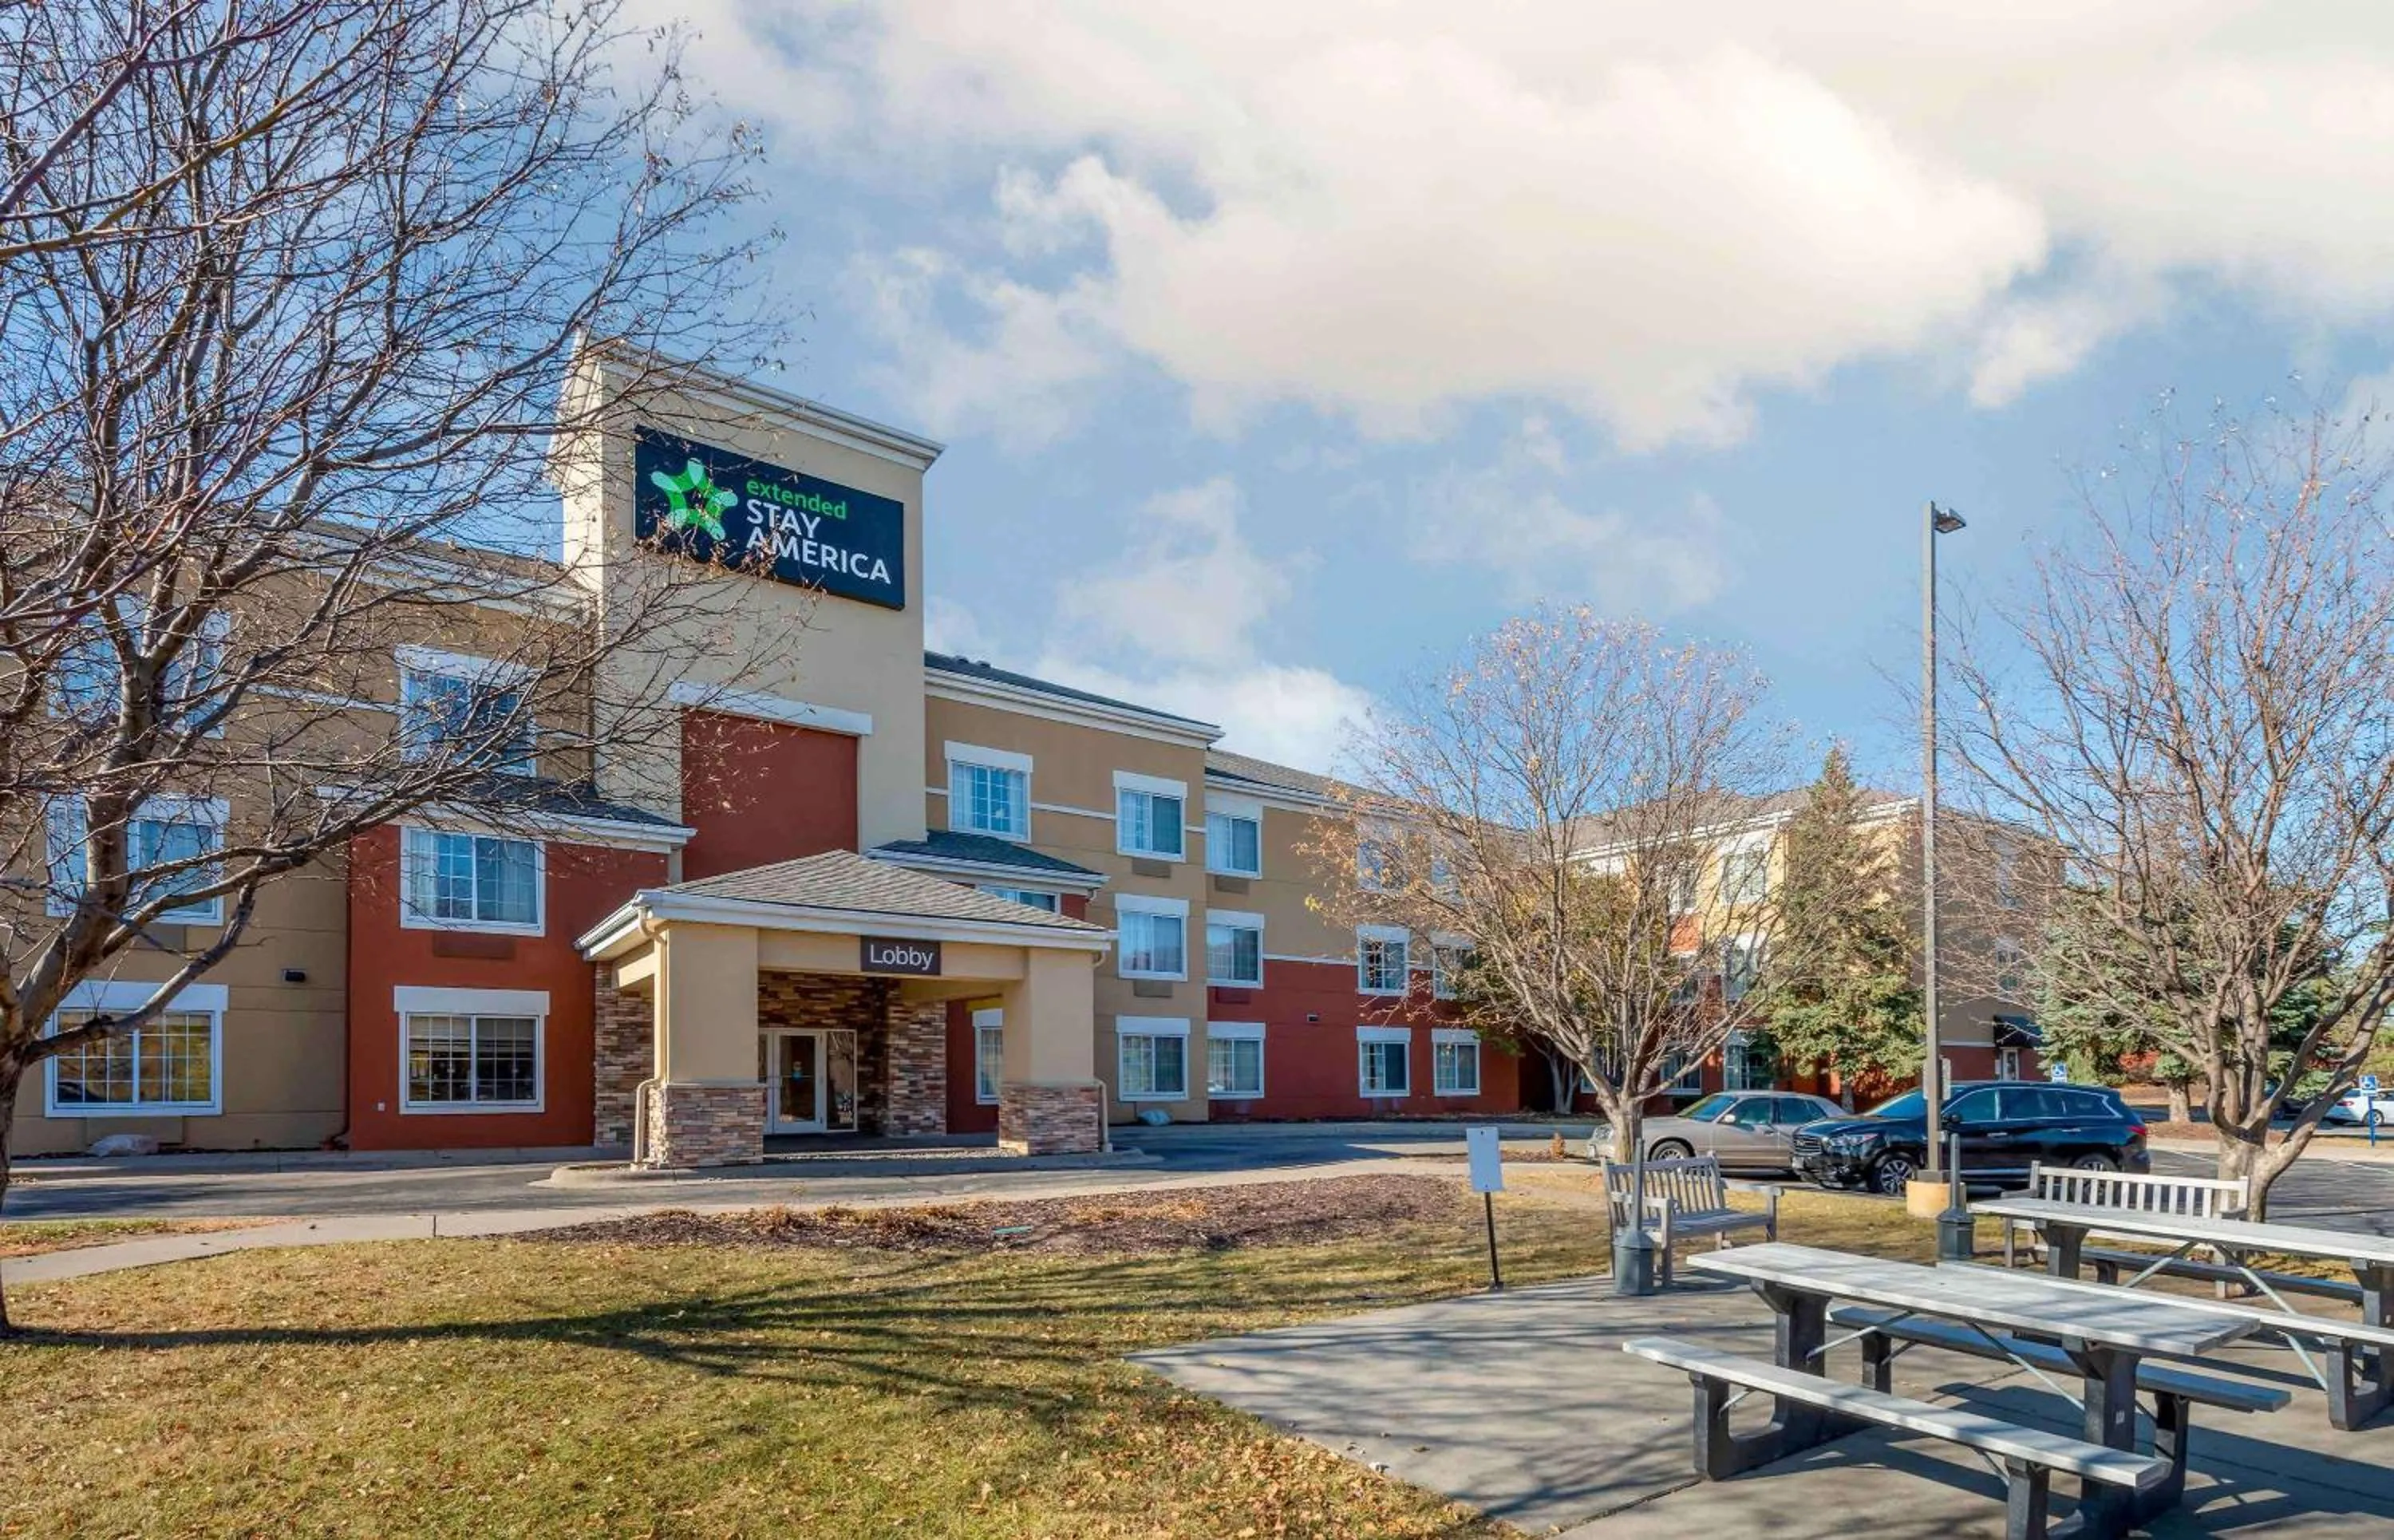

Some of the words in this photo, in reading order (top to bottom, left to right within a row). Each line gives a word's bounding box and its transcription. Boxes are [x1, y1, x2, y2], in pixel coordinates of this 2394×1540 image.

[746, 480, 847, 519] extended
[746, 499, 821, 539] STAY
[746, 527, 891, 585] AMERICA
[870, 944, 934, 970] Lobby
